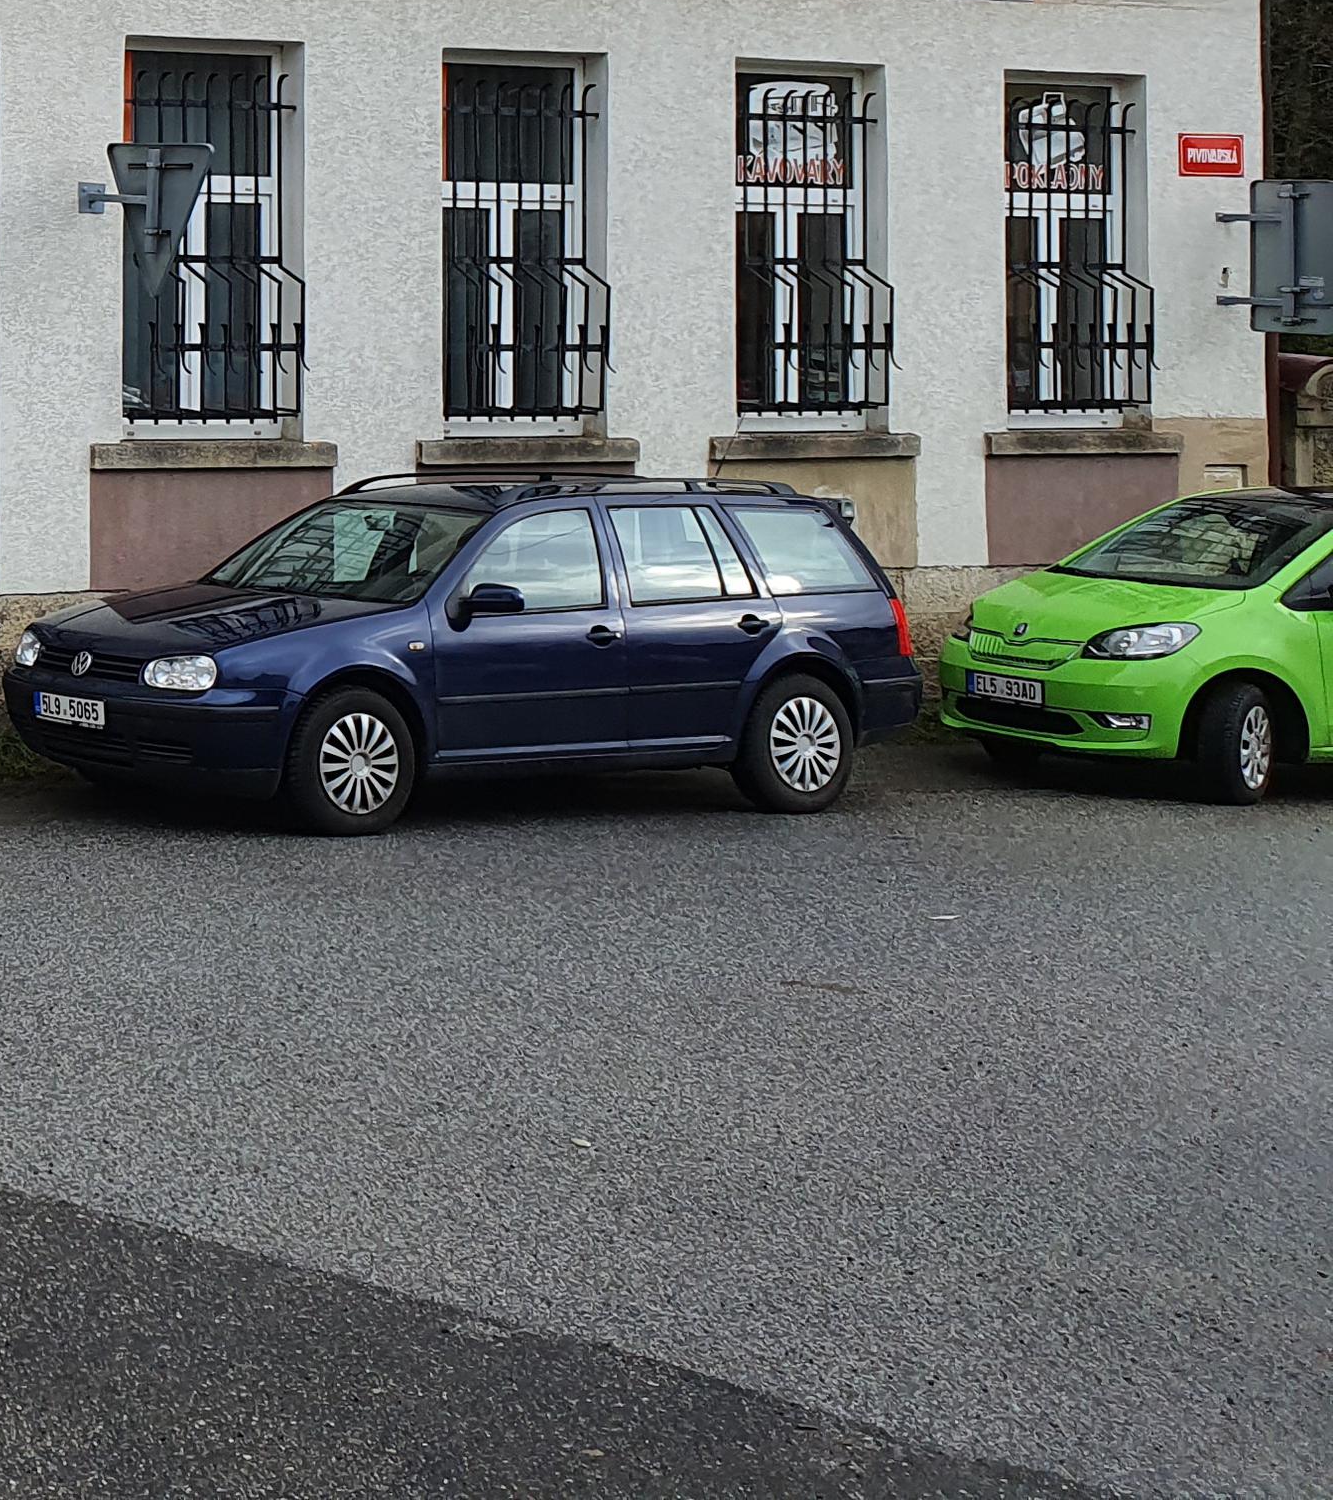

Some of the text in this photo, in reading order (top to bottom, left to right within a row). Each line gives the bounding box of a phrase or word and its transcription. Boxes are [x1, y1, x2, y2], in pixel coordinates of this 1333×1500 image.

[1186, 145, 1238, 165] PIVOVARSKÁ
[976, 675, 1036, 700] EL5 93AD
[42, 694, 99, 721] 5L9 5065
